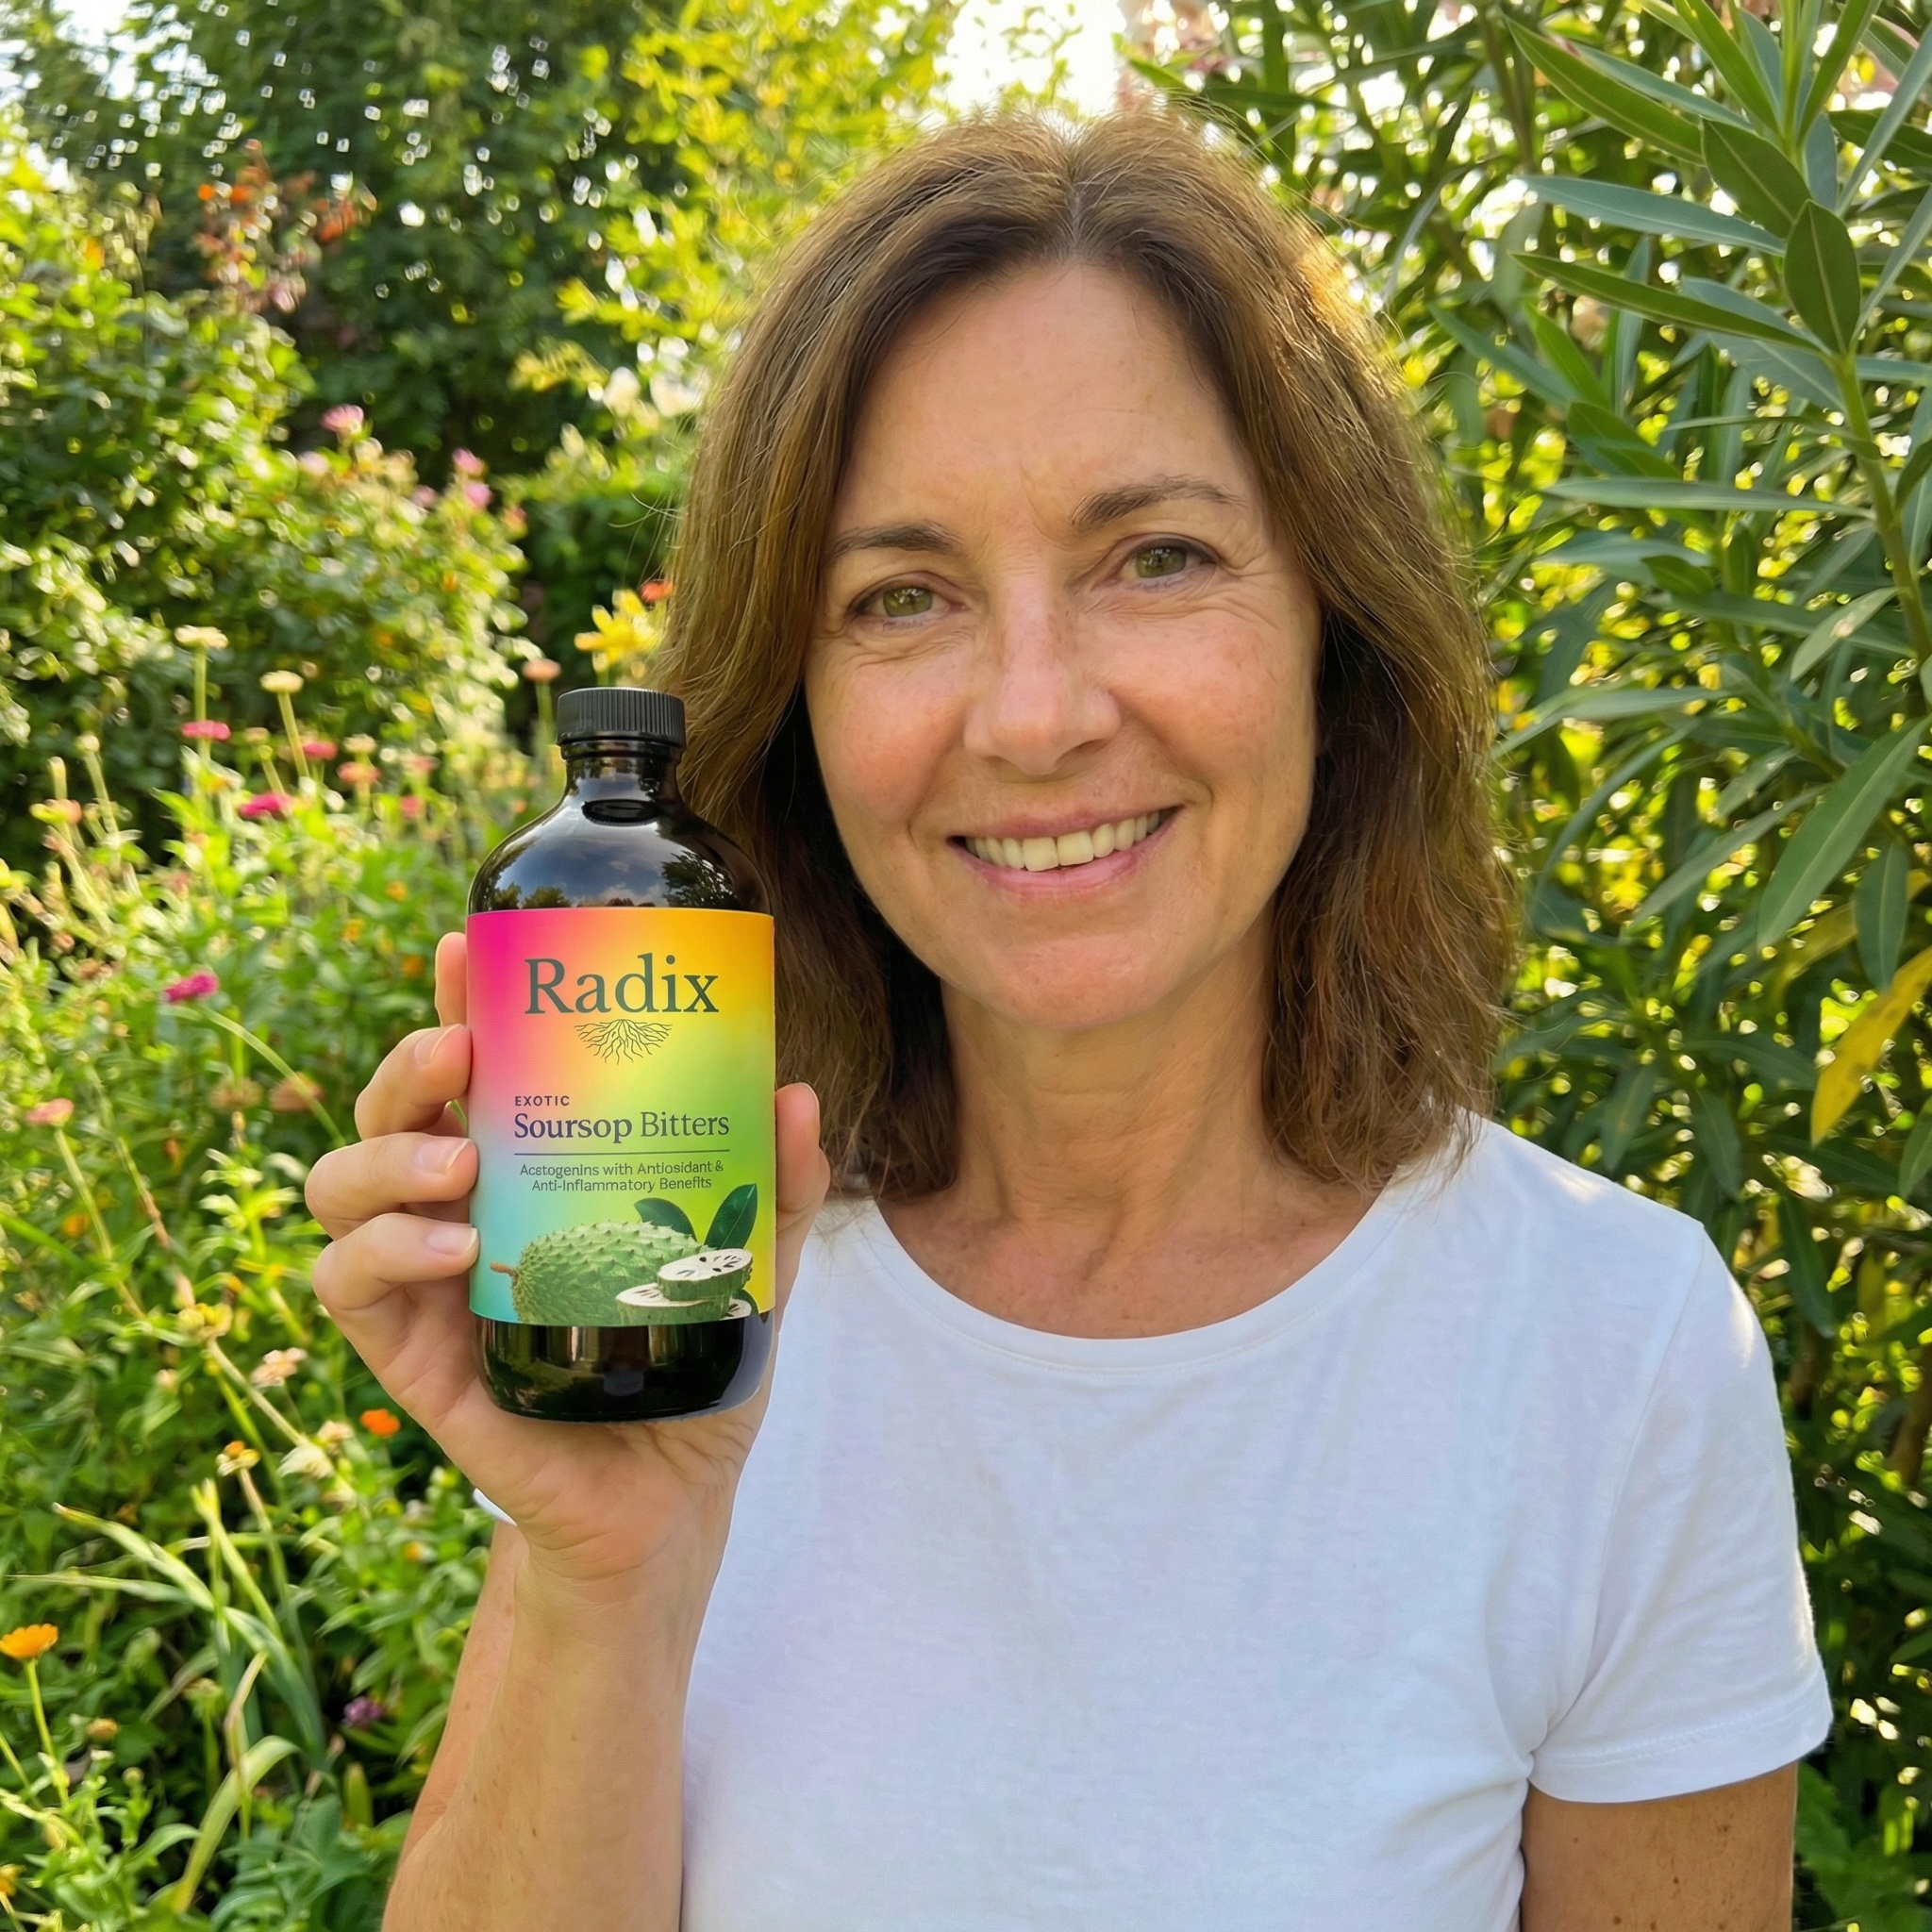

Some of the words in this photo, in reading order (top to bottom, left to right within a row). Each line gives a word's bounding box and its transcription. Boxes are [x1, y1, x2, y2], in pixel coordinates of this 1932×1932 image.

[525, 952, 719, 1014] Radix
[514, 1095, 570, 1107] EXOTIC
[514, 1112, 633, 1144] Soursop
[640, 1110, 730, 1138] Bitters
[602, 1162, 633, 1175] with
[715, 1159, 724, 1172] &
[532, 1178, 655, 1193] Anti-Inflammatory
[659, 1175, 712, 1190] Benefits
